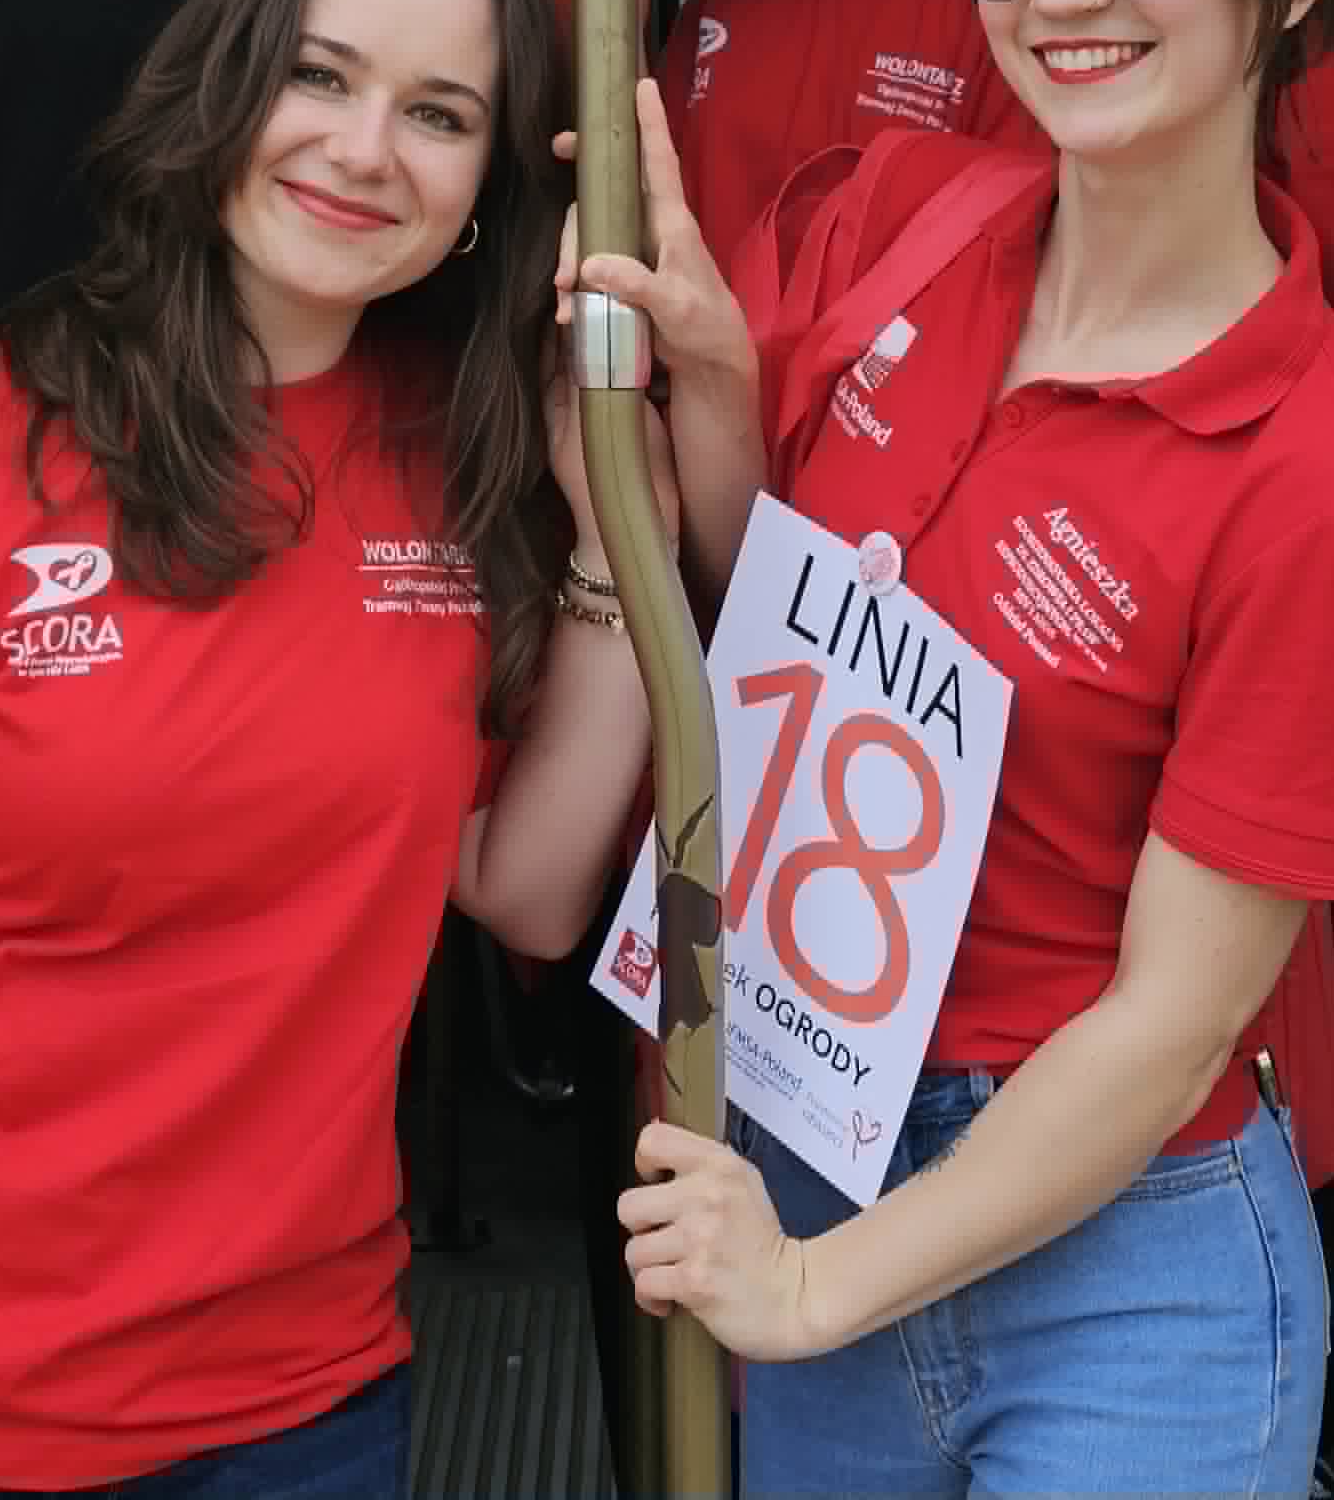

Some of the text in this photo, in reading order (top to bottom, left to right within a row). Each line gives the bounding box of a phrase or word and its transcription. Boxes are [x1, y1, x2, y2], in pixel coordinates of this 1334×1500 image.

[1042, 507, 1139, 621] Agnieszka
[0, 613, 124, 664] SCORA
[784, 553, 964, 761] LINIA
[724, 662, 947, 1024] 18
[755, 983, 872, 1088] OGRODY
